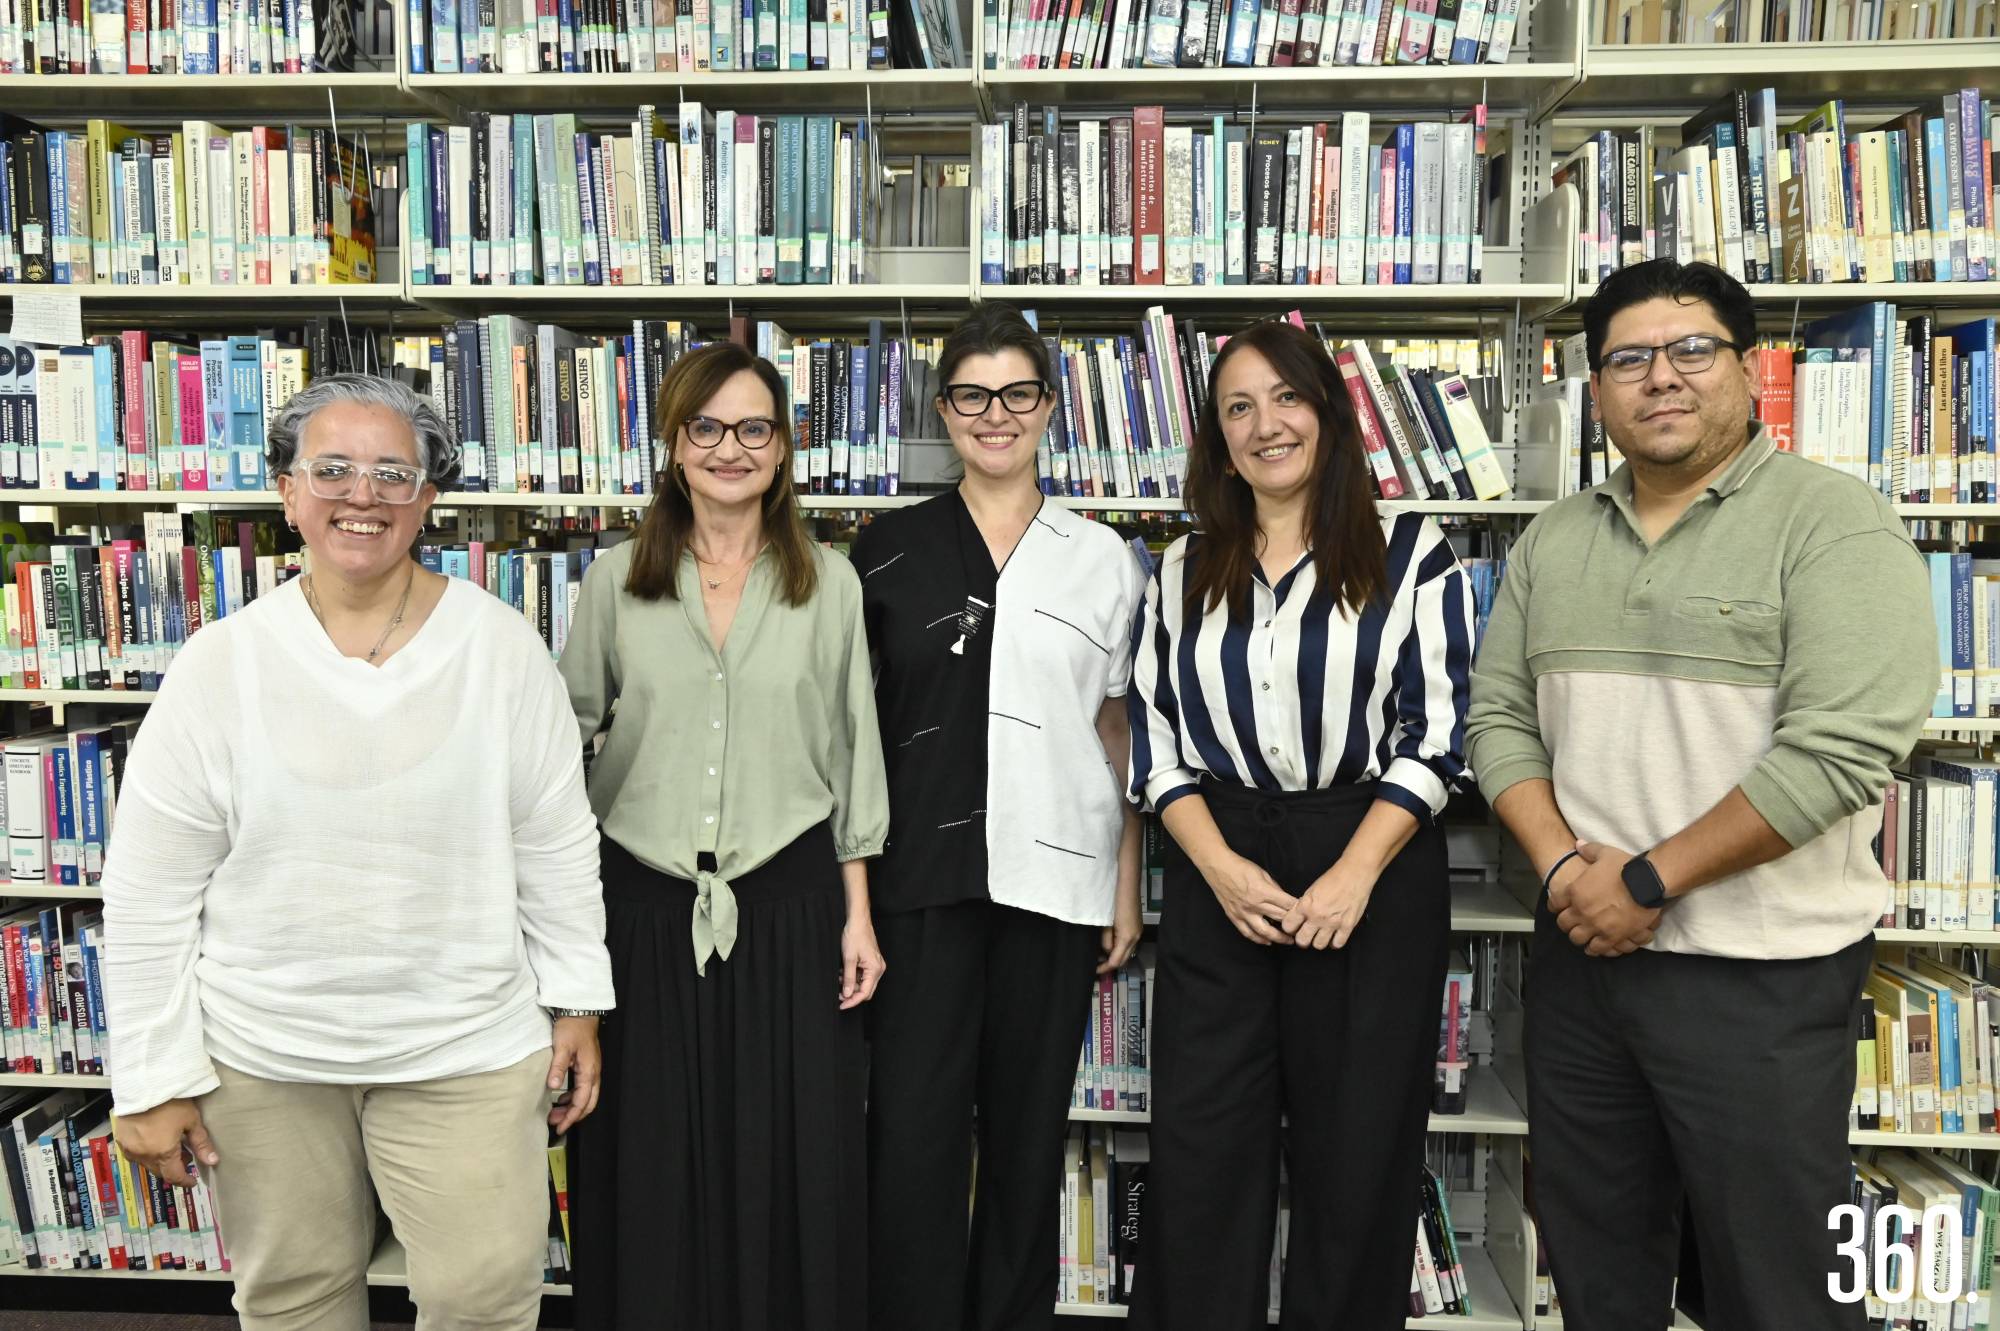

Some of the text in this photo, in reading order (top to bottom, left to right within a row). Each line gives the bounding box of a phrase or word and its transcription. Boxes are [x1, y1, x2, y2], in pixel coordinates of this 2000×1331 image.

[810, 124, 818, 174] OPERATIONS
[1148, 140, 1156, 205] Fundamentos de
[1264, 155, 1272, 200] Procesos de
[1627, 142, 1636, 226] AIR CARGO STRATEGY
[1752, 174, 1762, 198] THE
[162, 185, 173, 214] Production
[1919, 189, 1924, 197] de
[1952, 186, 1960, 199] DEL
[559, 360, 569, 401] SHINGO
[579, 358, 589, 399] SHINGO
[1365, 361, 1410, 456] SALVATORE FERRAG
[200, 545, 208, 569] VINO
[81, 572, 92, 611] Hydrogen
[119, 554, 132, 644] Principios de Refrig
[1962, 580, 1970, 603] LIBRARY
[191, 601, 199, 622] VINO
[542, 619, 547, 628] DE
[86, 624, 94, 640] Fuel
[57, 753, 68, 816] Plastics Engineering
[88, 803, 96, 835] Industria
[15, 950, 23, 970] Color
[53, 956, 61, 970] 50
[1103, 992, 1112, 1054] HIP HOTELS
[72, 1141, 80, 1157] CINE
[75, 1162, 84, 1181] VIDEO
[1120, 1181, 1145, 1244] Strategy
